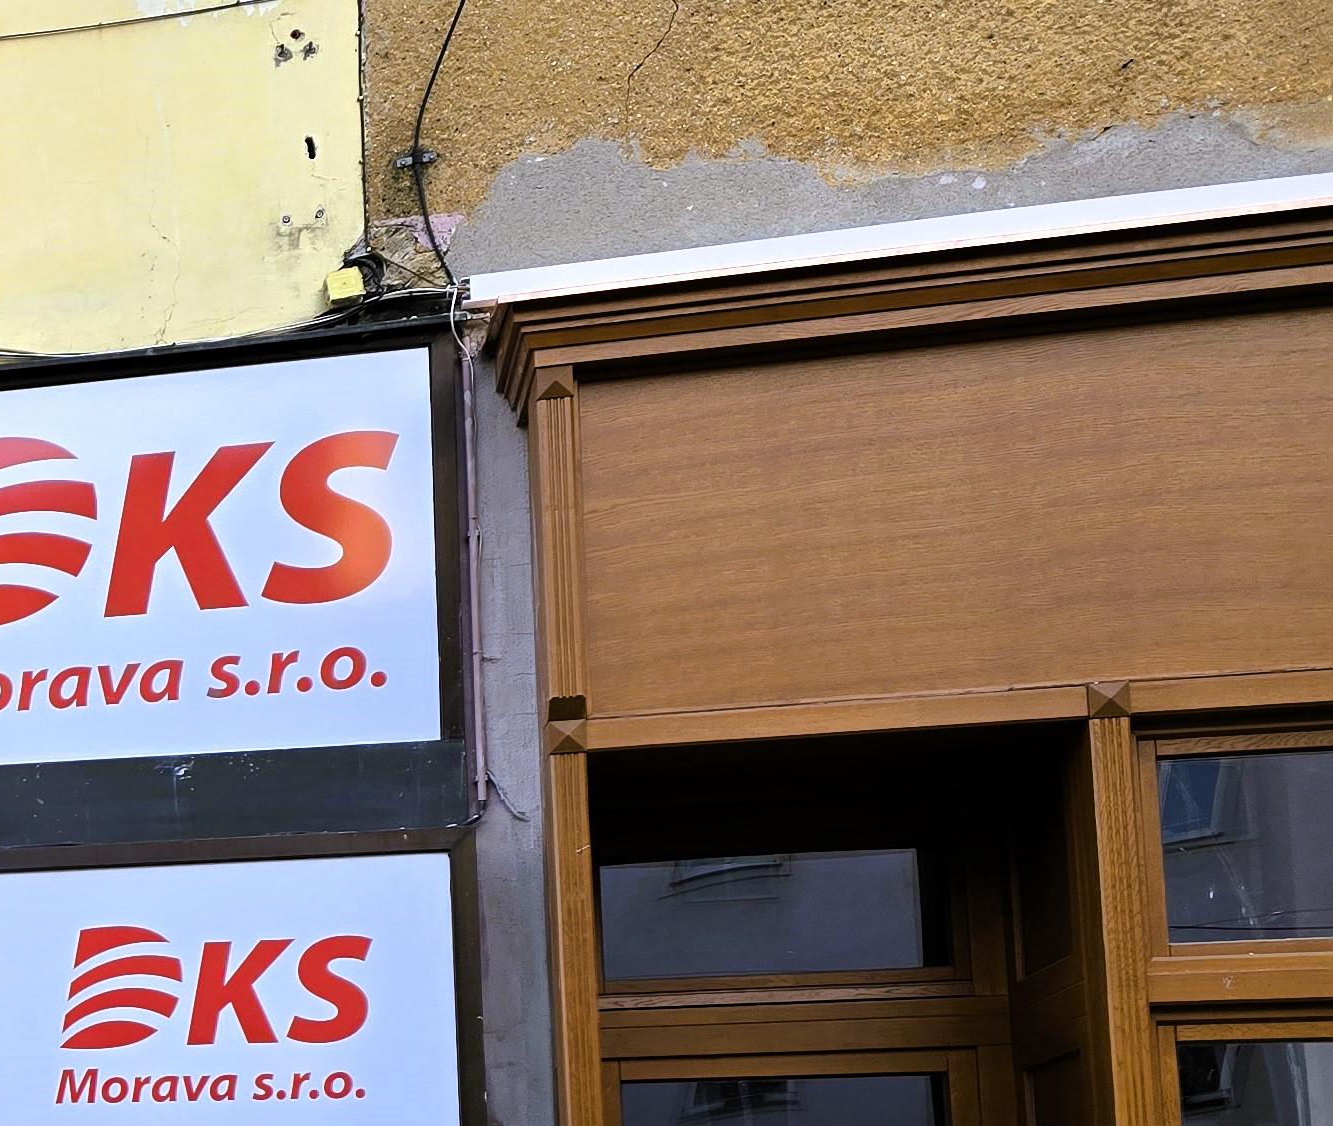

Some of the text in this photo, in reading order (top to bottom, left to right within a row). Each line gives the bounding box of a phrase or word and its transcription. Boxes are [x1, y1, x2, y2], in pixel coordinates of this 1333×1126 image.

[205, 646, 387, 700] s.r.o.
[56, 1069, 364, 1104] Morava s.r.o.
